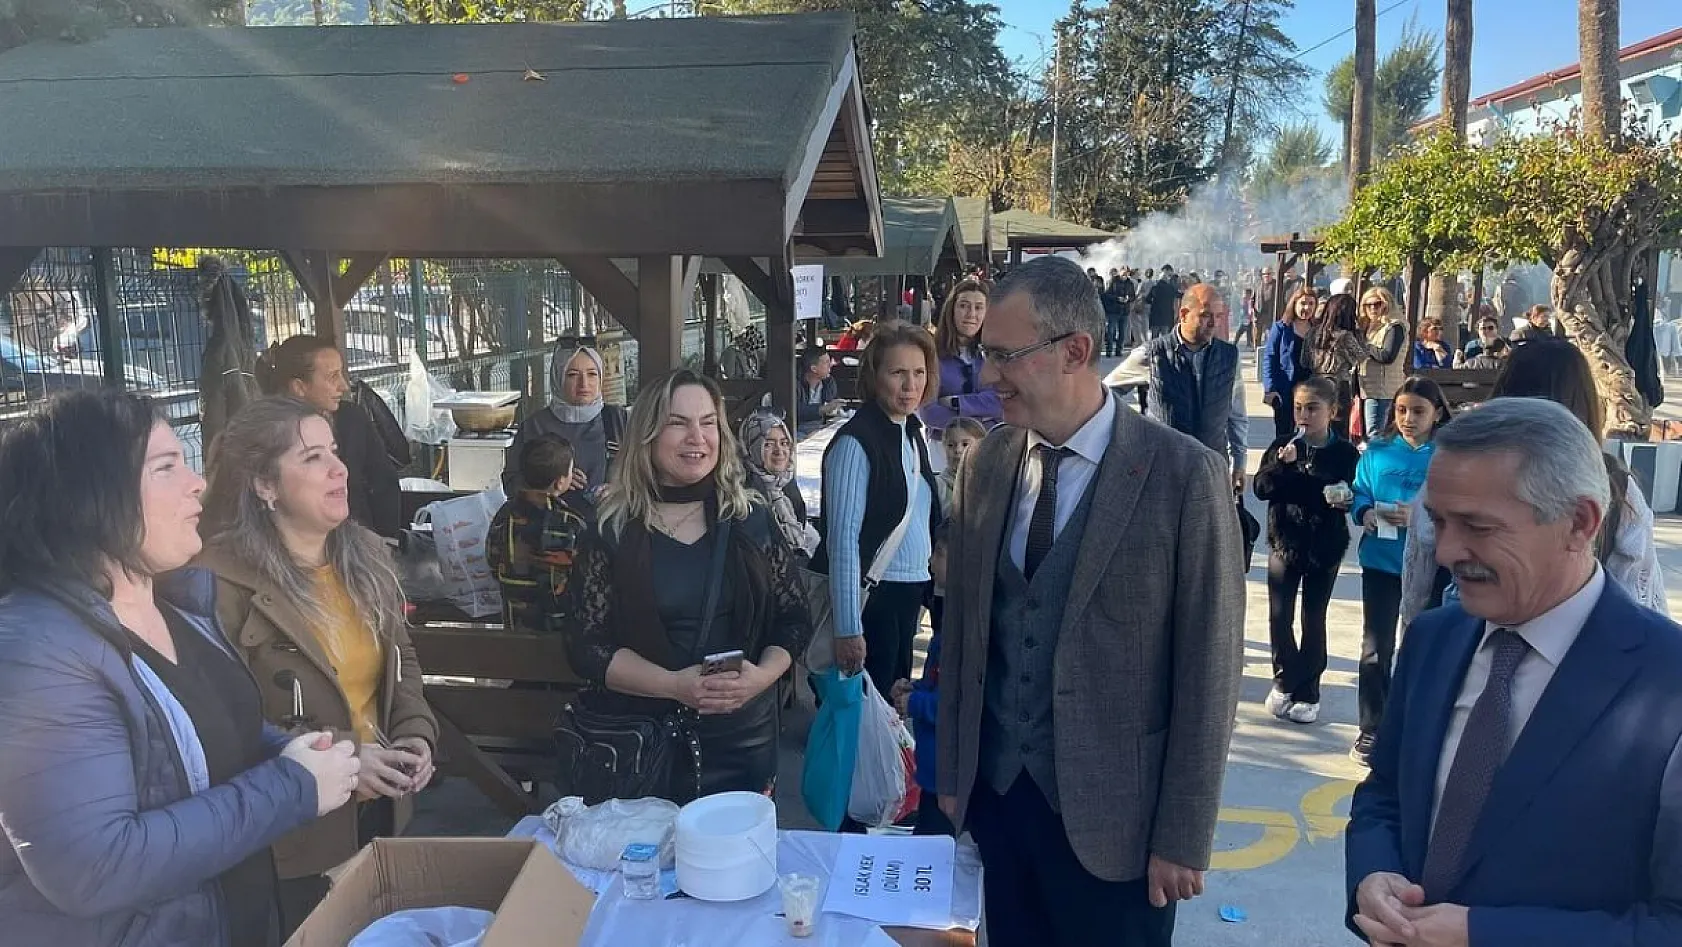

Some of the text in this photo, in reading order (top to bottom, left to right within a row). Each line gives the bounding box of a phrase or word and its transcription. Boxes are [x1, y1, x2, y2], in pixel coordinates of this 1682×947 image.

[859, 854, 875, 871] KEK
[914, 864, 932, 892] 30 TL
